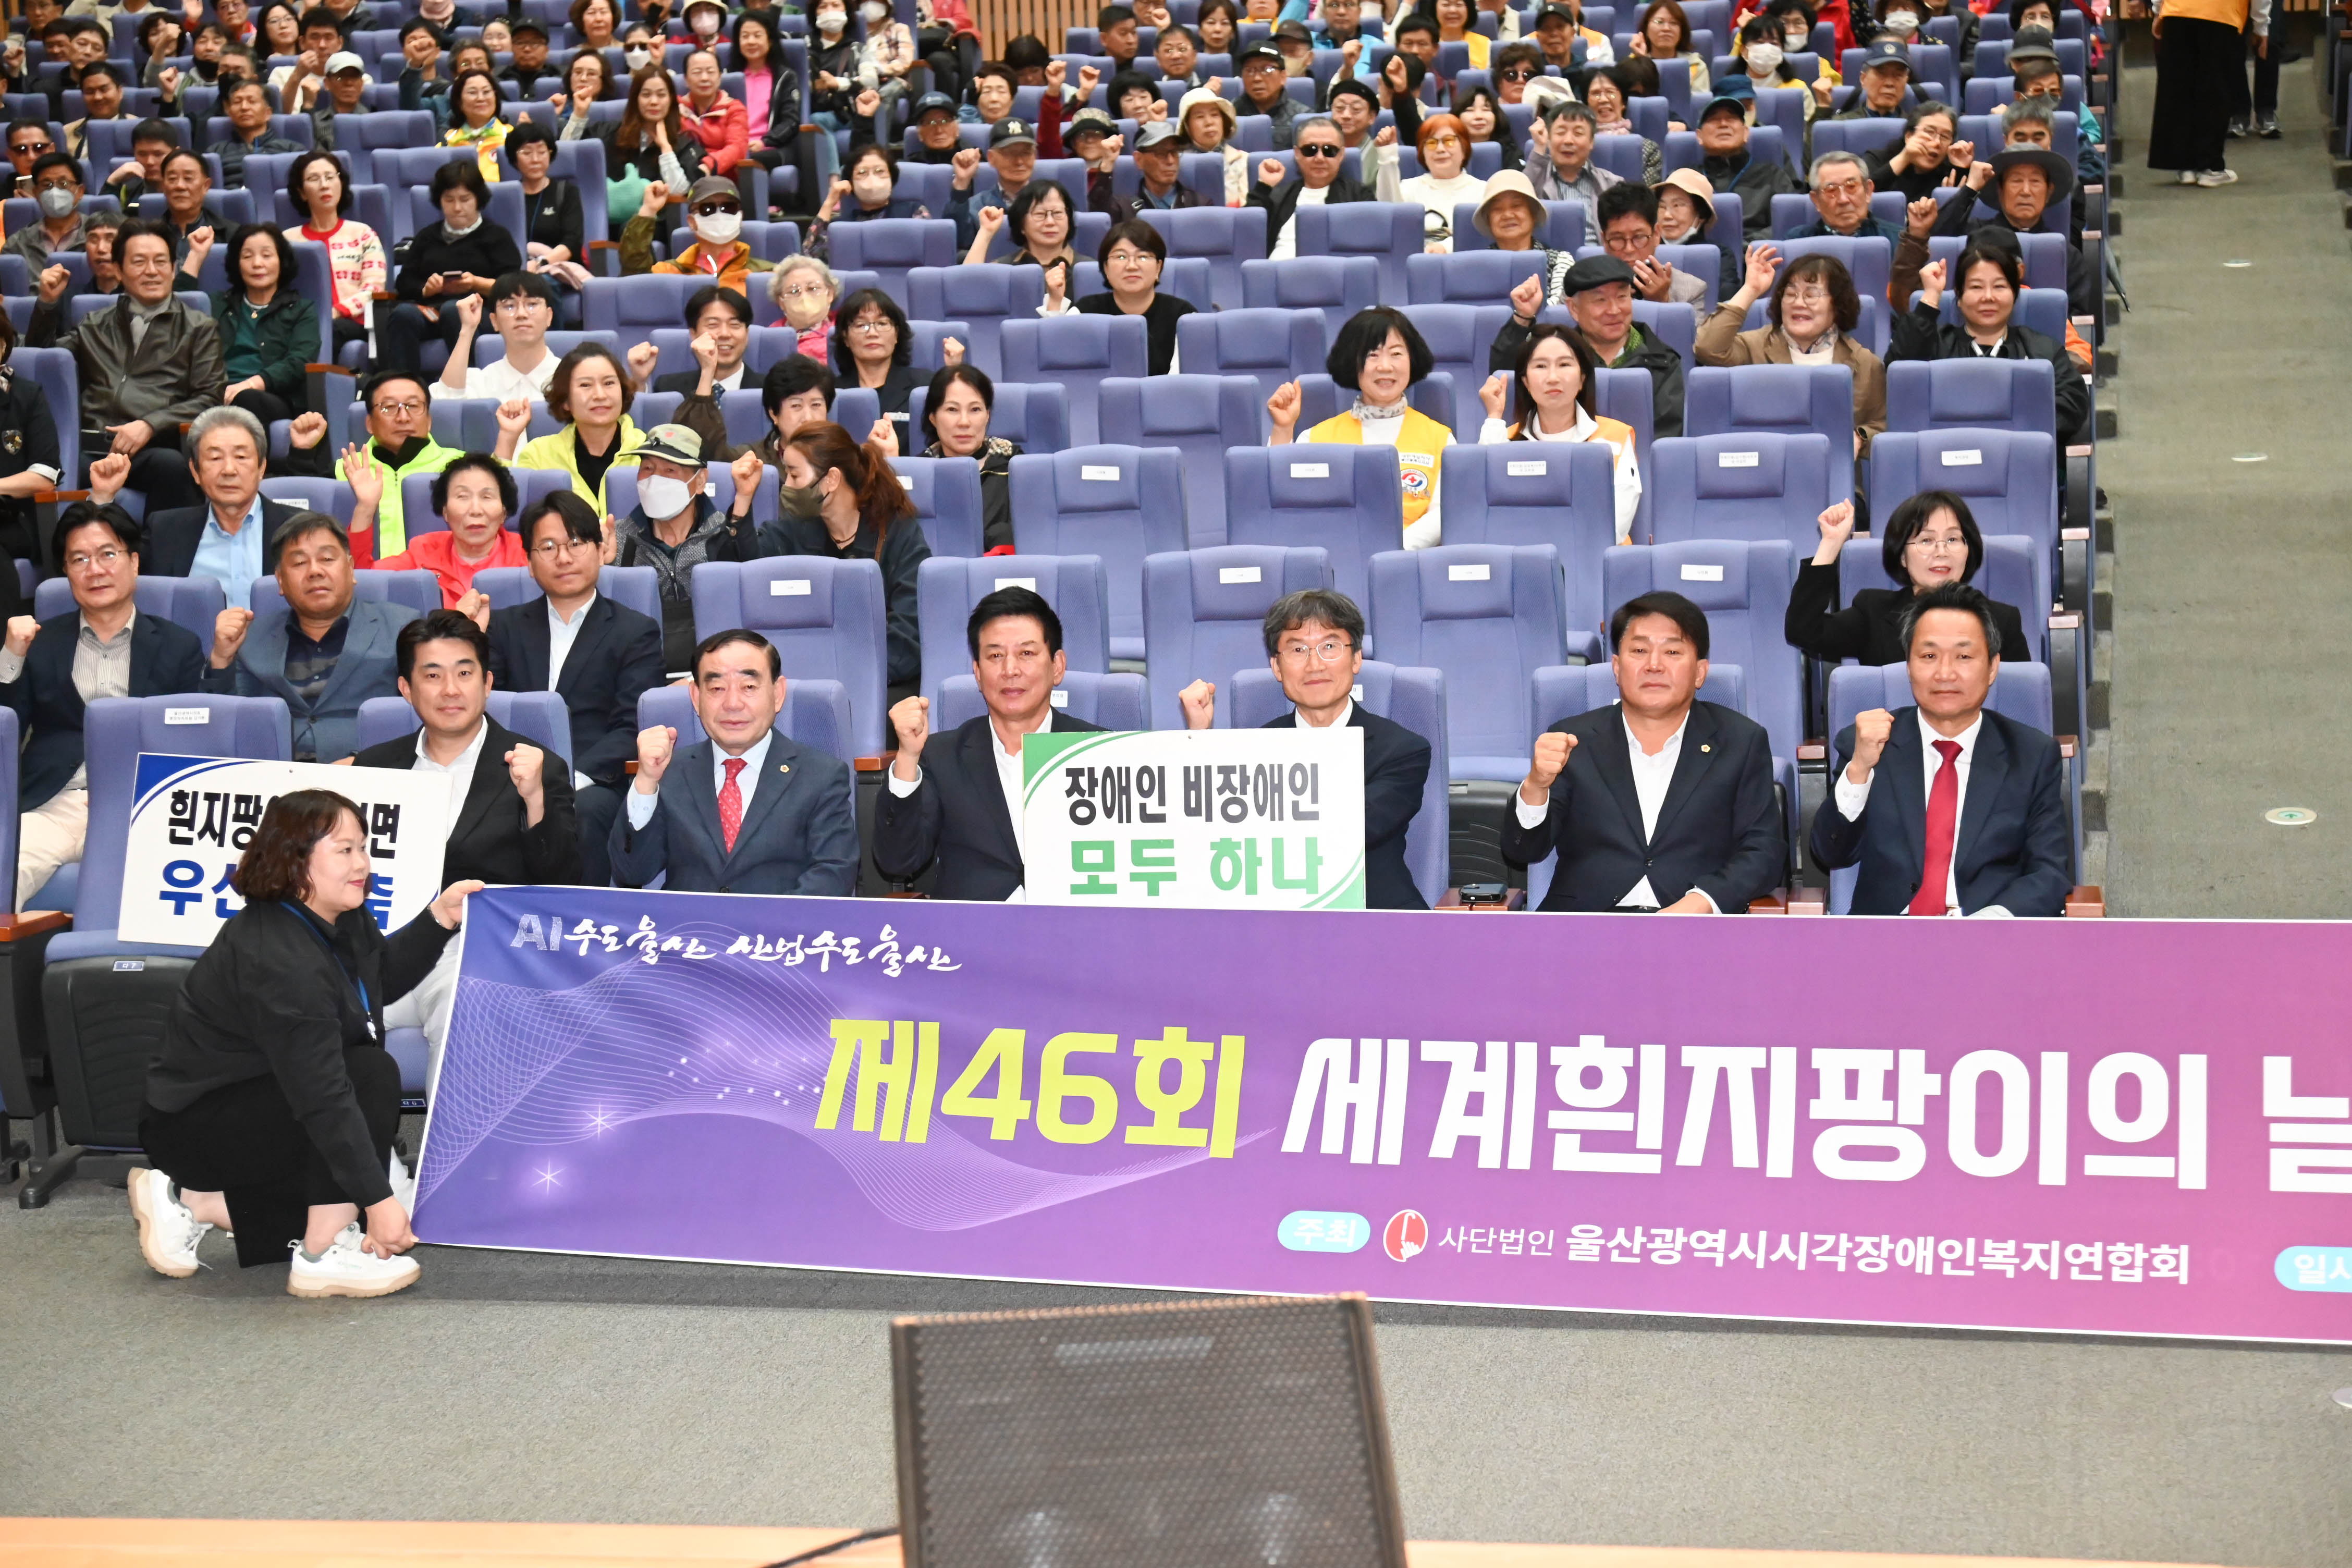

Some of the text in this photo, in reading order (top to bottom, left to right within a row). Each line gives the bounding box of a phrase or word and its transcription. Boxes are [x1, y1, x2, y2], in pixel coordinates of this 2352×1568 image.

[168, 789, 279, 851] 흰지팡
[1065, 763, 1320, 825] 장애인 비장애인
[1070, 837, 1323, 896] 모두 하나
[814, 1019, 1245, 1158] 제46회
[1281, 1035, 2207, 1190] 세계흰지팡이의
[1293, 1217, 2189, 1285] 주최 사단법인 울산광역시시각장애인복지연합회
